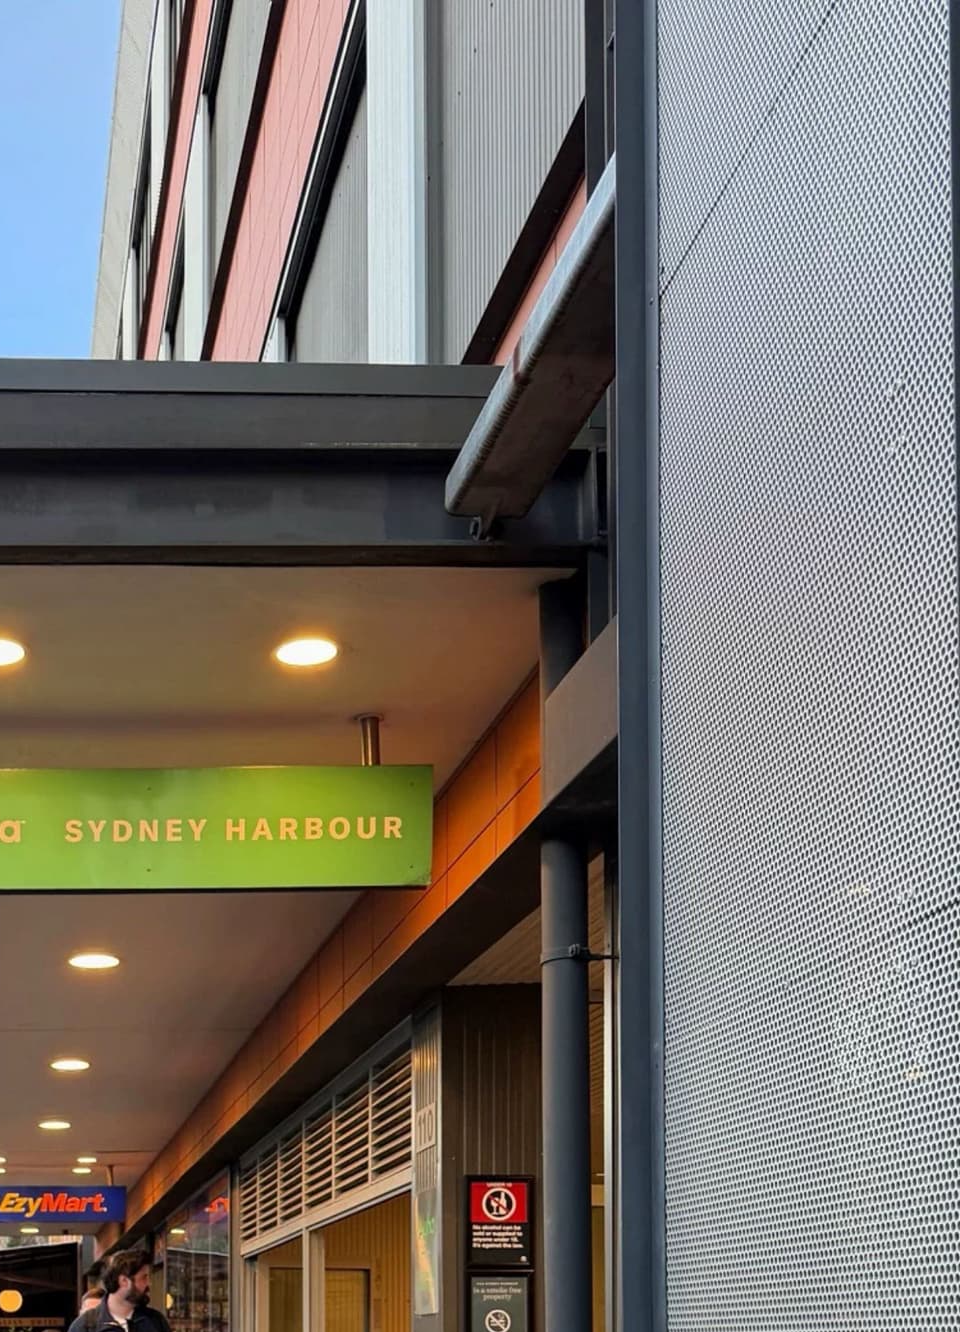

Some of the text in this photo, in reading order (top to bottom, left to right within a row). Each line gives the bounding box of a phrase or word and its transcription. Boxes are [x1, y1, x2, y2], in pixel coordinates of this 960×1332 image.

[64, 818, 208, 843] SYDNEY
[224, 816, 404, 842] HARBOUR
[418, 1110, 434, 1147] 110
